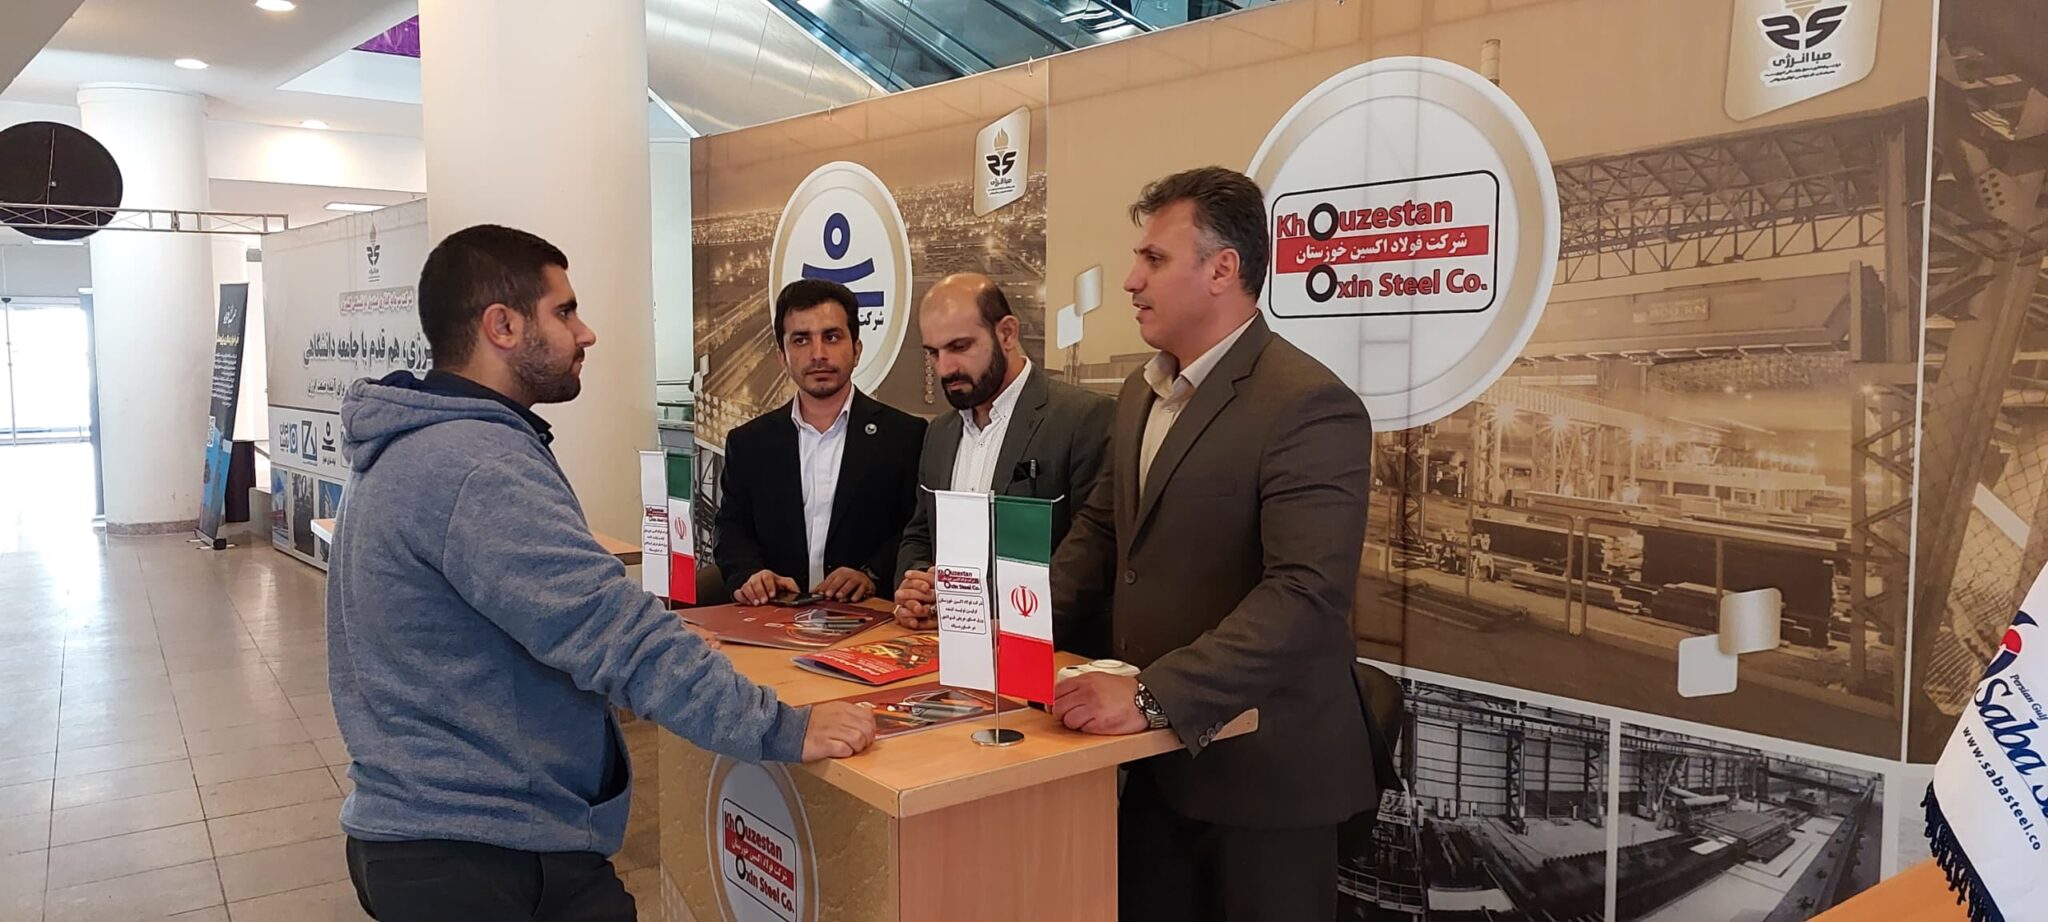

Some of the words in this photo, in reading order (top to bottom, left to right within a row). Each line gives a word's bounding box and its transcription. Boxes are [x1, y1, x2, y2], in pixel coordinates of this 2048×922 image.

[1772, 52, 1810, 69] انرژی
[1811, 51, 1833, 65] صبا
[1295, 242, 1348, 264] خوزستان
[1350, 238, 1389, 261] اکسین
[1390, 234, 1423, 257] فولاد
[1426, 231, 1468, 254] شرکت
[1305, 263, 1374, 303] Oxin
[1378, 269, 1441, 297] Steel
[1446, 268, 1488, 294] Co.
[2009, 673, 2034, 703] Persian
[2031, 702, 2048, 721] Gulf
[1974, 677, 2048, 775] Saba
[1963, 726, 2041, 851] www.sabasteel.co
[735, 854, 759, 889] Oxin
[759, 877, 780, 904] Steel
